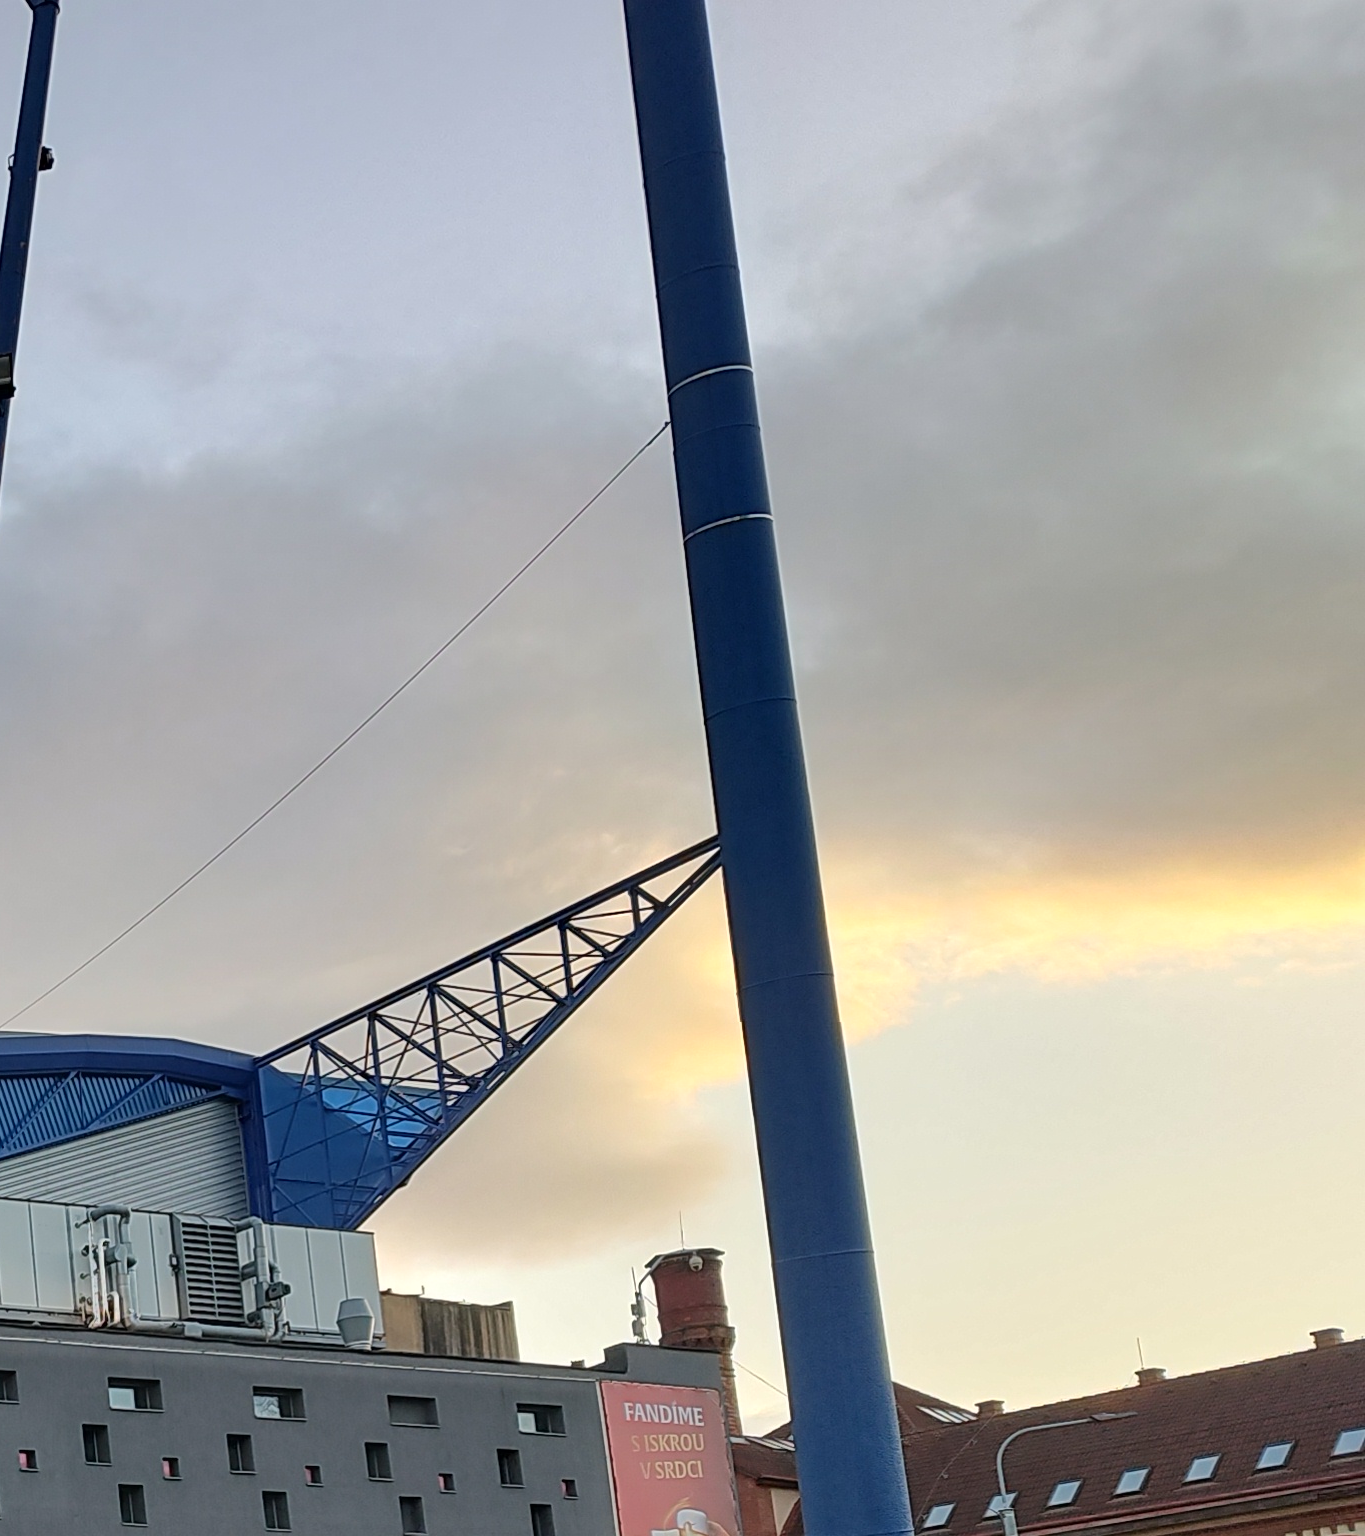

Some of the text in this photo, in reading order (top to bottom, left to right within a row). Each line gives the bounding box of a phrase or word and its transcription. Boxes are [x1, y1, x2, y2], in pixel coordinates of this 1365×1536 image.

[624, 1400, 704, 1426] FANDÍME
[631, 1433, 705, 1452] S ISKROU
[639, 1460, 704, 1479] V SRDCI
